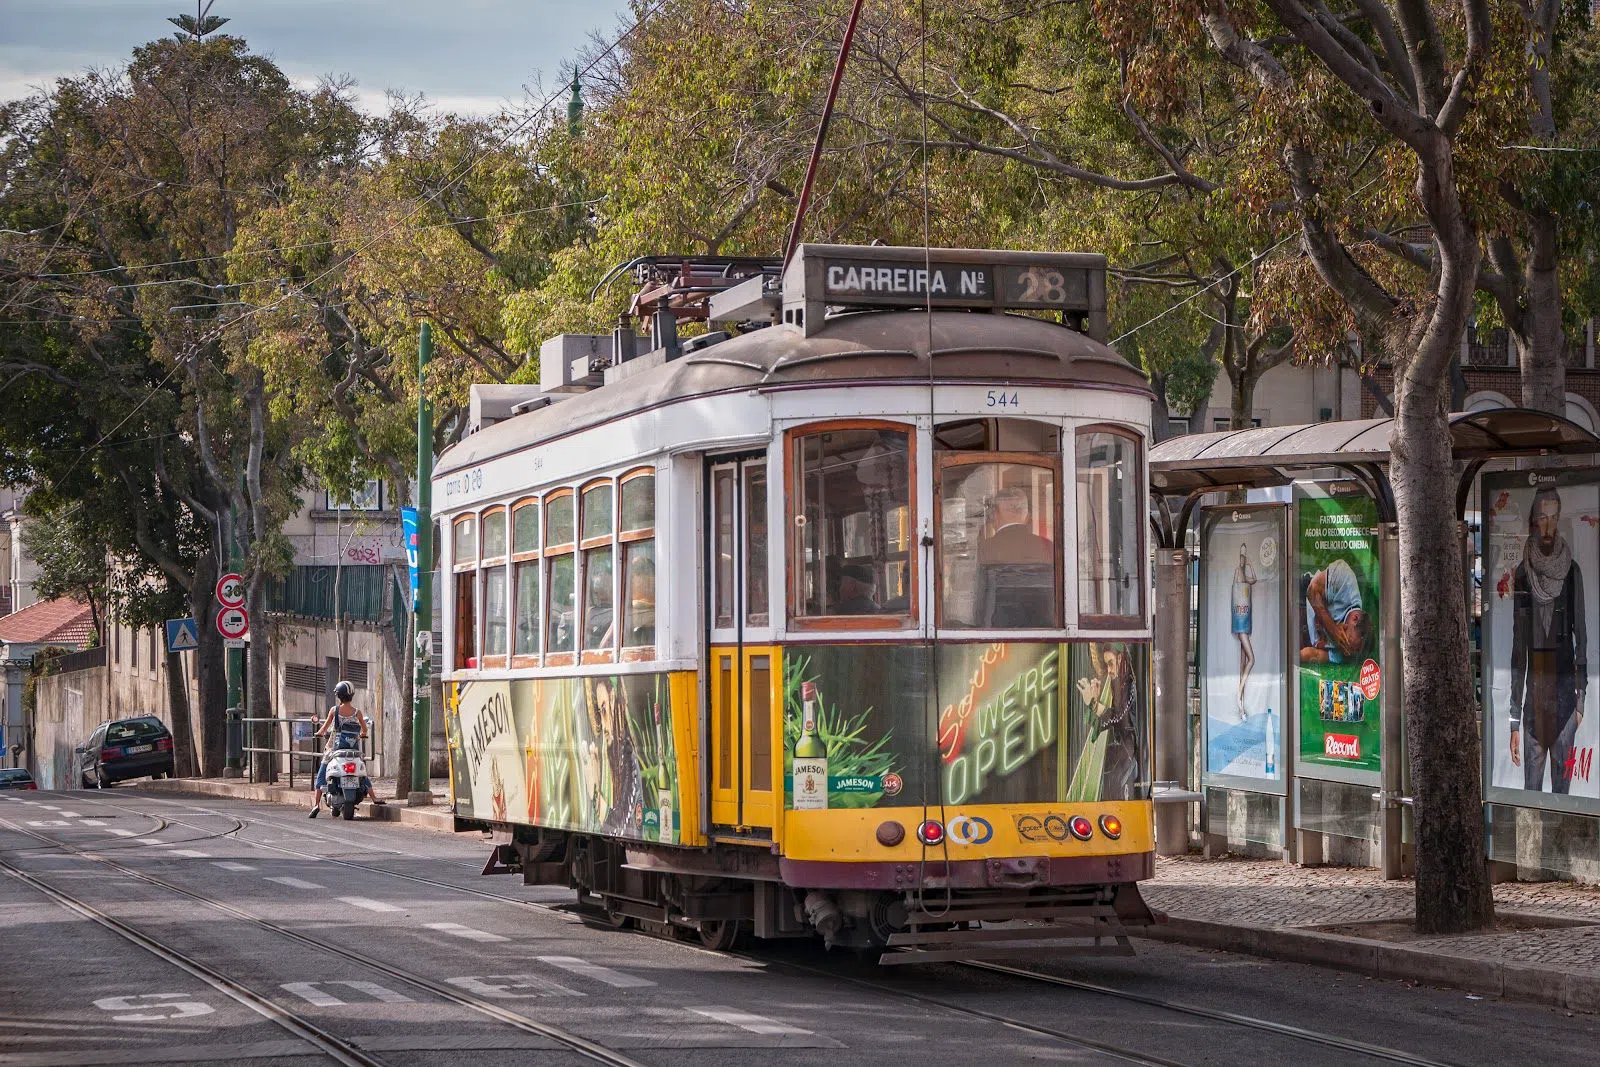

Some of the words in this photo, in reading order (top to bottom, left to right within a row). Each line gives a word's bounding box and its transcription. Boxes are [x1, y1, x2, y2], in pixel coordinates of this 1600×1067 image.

[828, 266, 947, 293] CARREIRA
[1017, 271, 1067, 303] 28
[986, 390, 1020, 408] 544
[468, 692, 511, 787] JAMESON
[949, 692, 1052, 805] OPEN
[1325, 735, 1359, 757] Record
[795, 765, 825, 776] JAMESON
[1563, 745, 1593, 783] H&M
[836, 777, 875, 790] JAMESON
